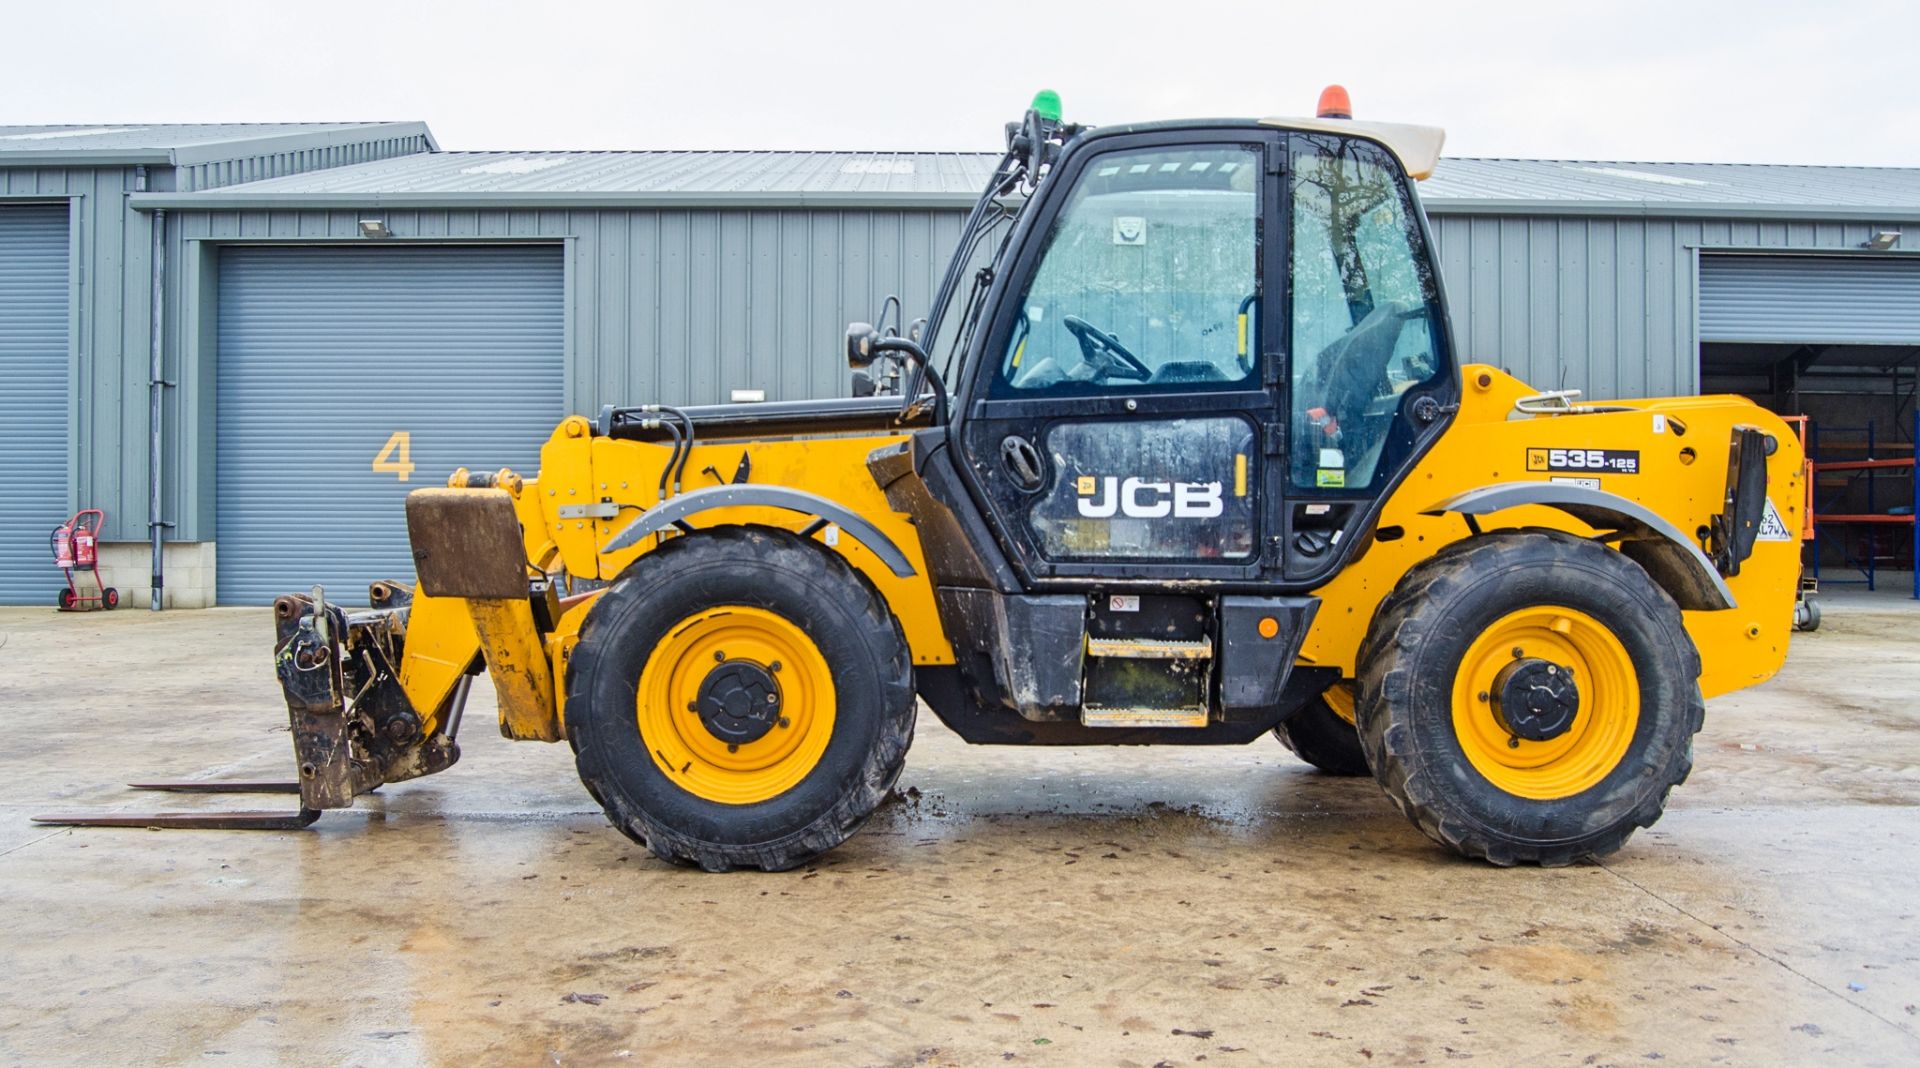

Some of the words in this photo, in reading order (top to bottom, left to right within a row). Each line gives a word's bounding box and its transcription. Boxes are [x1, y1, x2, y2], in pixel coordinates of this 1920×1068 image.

[372, 431, 416, 481] 4
[1549, 449, 1636, 468] 535-125
[1078, 476, 1224, 518] JCB
